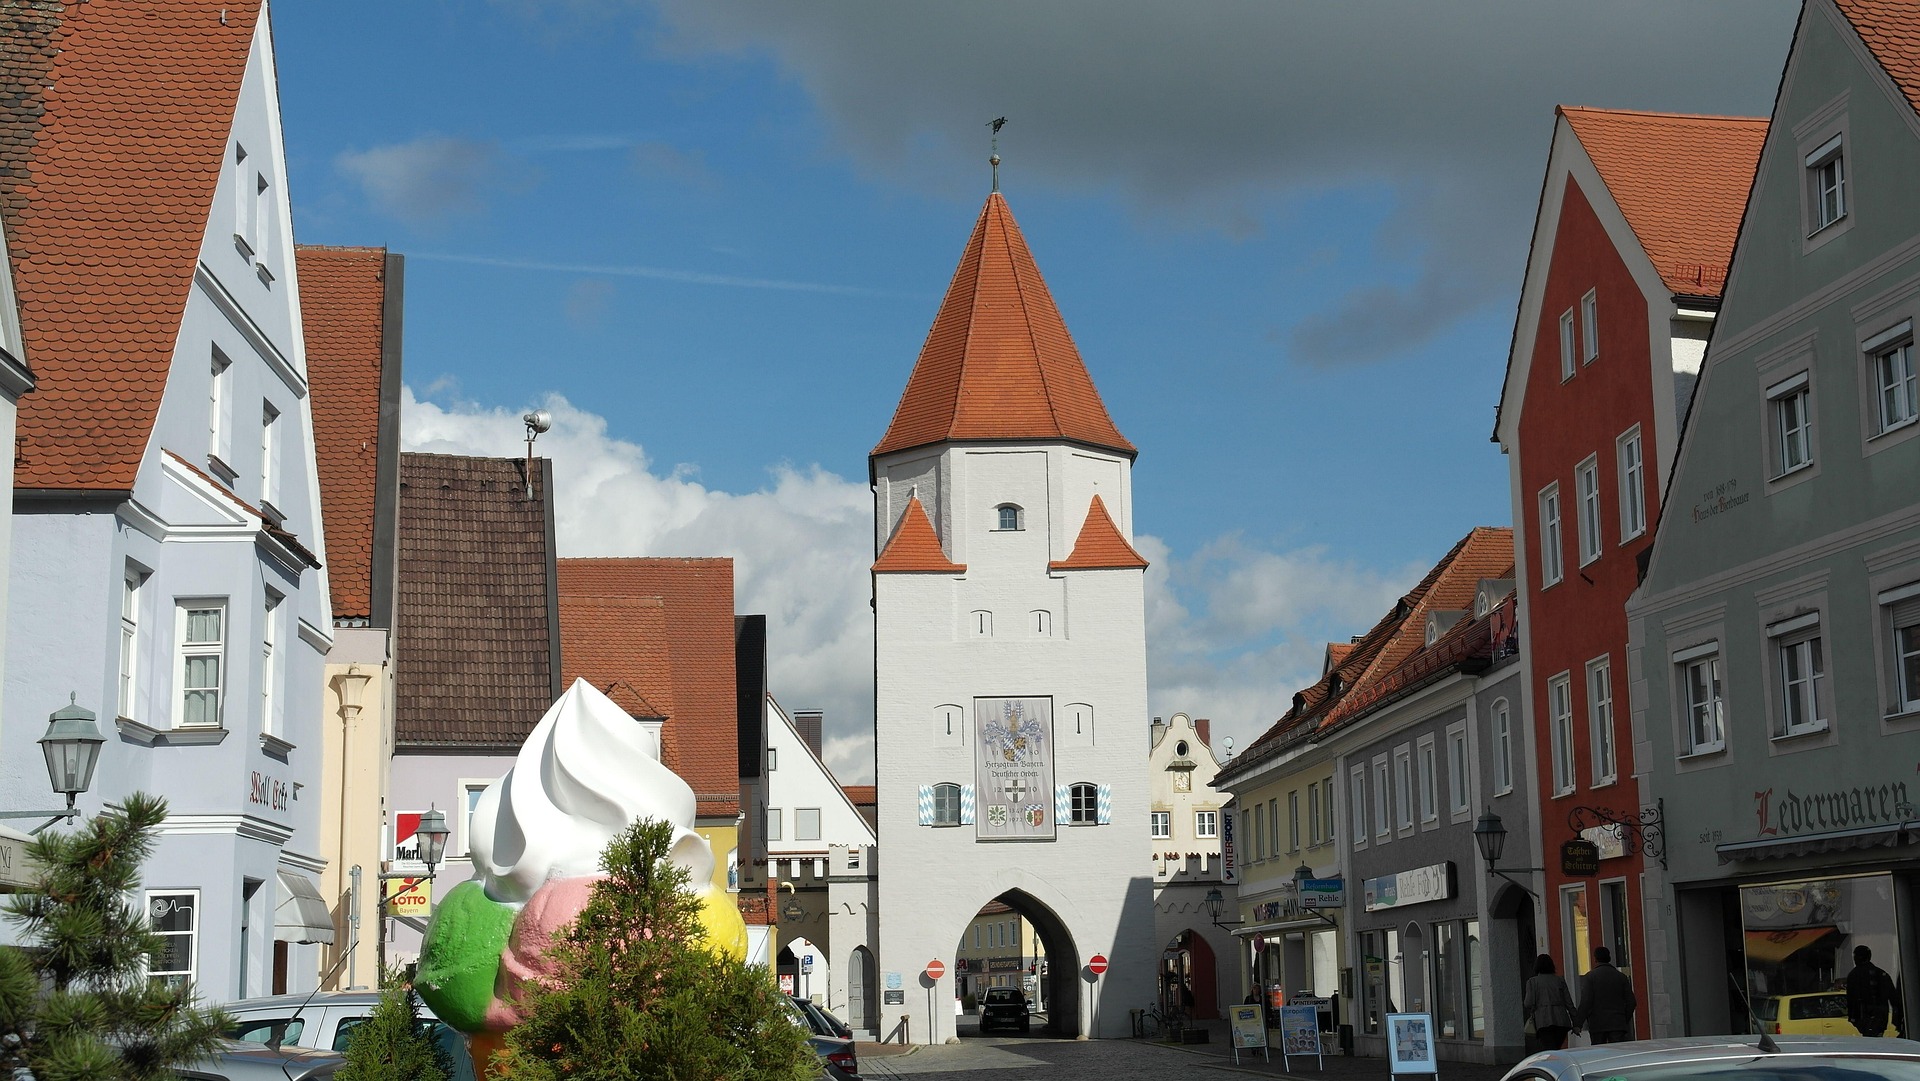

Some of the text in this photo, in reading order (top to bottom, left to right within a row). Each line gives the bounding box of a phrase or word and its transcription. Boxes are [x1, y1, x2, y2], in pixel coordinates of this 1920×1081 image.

[249, 770, 271, 807] Woll
[1754, 781, 1911, 837] Lederwaren
[1224, 812, 1234, 869] INTERSPORT
[1305, 882, 1339, 892] Reformhaus
[392, 896, 426, 906] LOTTO
[1318, 893, 1340, 903] Rehle
[399, 907, 419, 915] Bayern
